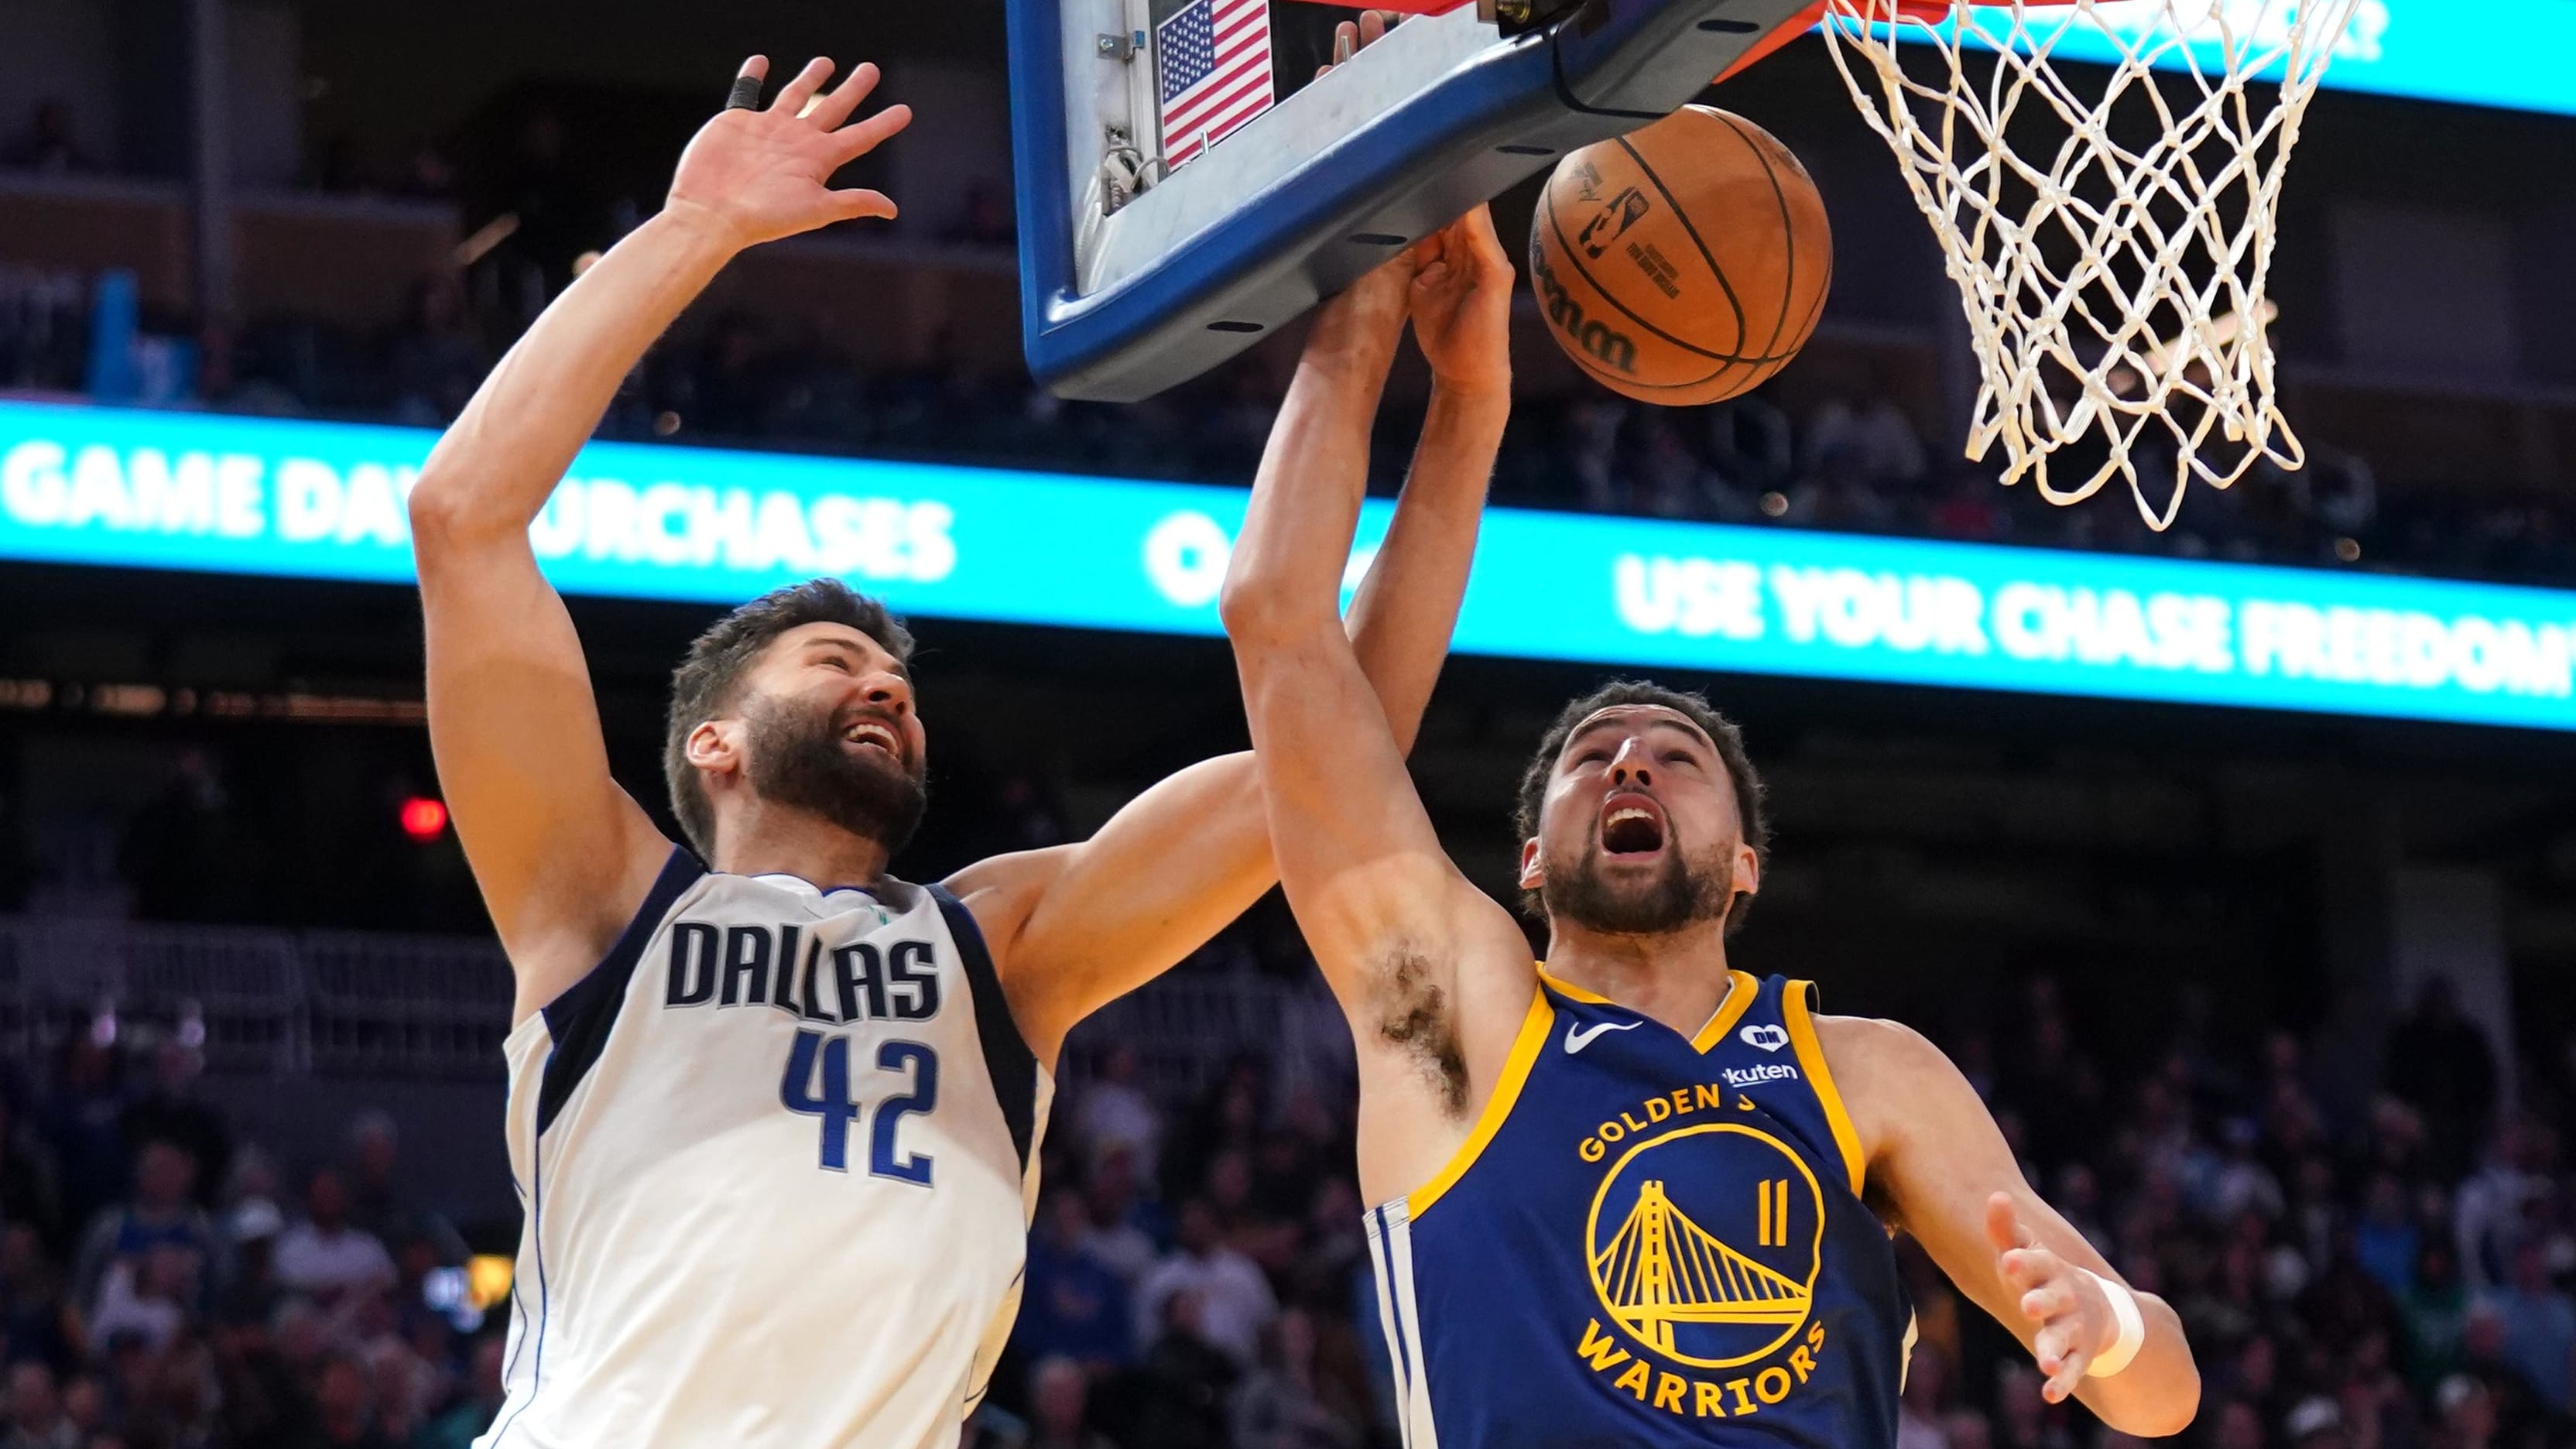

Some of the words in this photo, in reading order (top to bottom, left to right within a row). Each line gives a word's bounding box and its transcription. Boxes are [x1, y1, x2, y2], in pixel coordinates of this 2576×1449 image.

[2, 440, 265, 537] GAME
[528, 477, 956, 582] URCHASES
[1614, 554, 1763, 639] USE
[1769, 564, 1989, 655] YOUR
[1992, 582, 2234, 672] CHASE
[2239, 599, 2571, 697] FREEDOM
[663, 920, 943, 1026] DALLAS
[1721, 1064, 1798, 1084] kuten
[1752, 1030, 1782, 1044] DM
[779, 1026, 940, 1188] 42
[1579, 1084, 1721, 1163] GOLDEN
[1758, 1178, 1789, 1247] 11
[1576, 1317, 1826, 1418] WARRIORS
